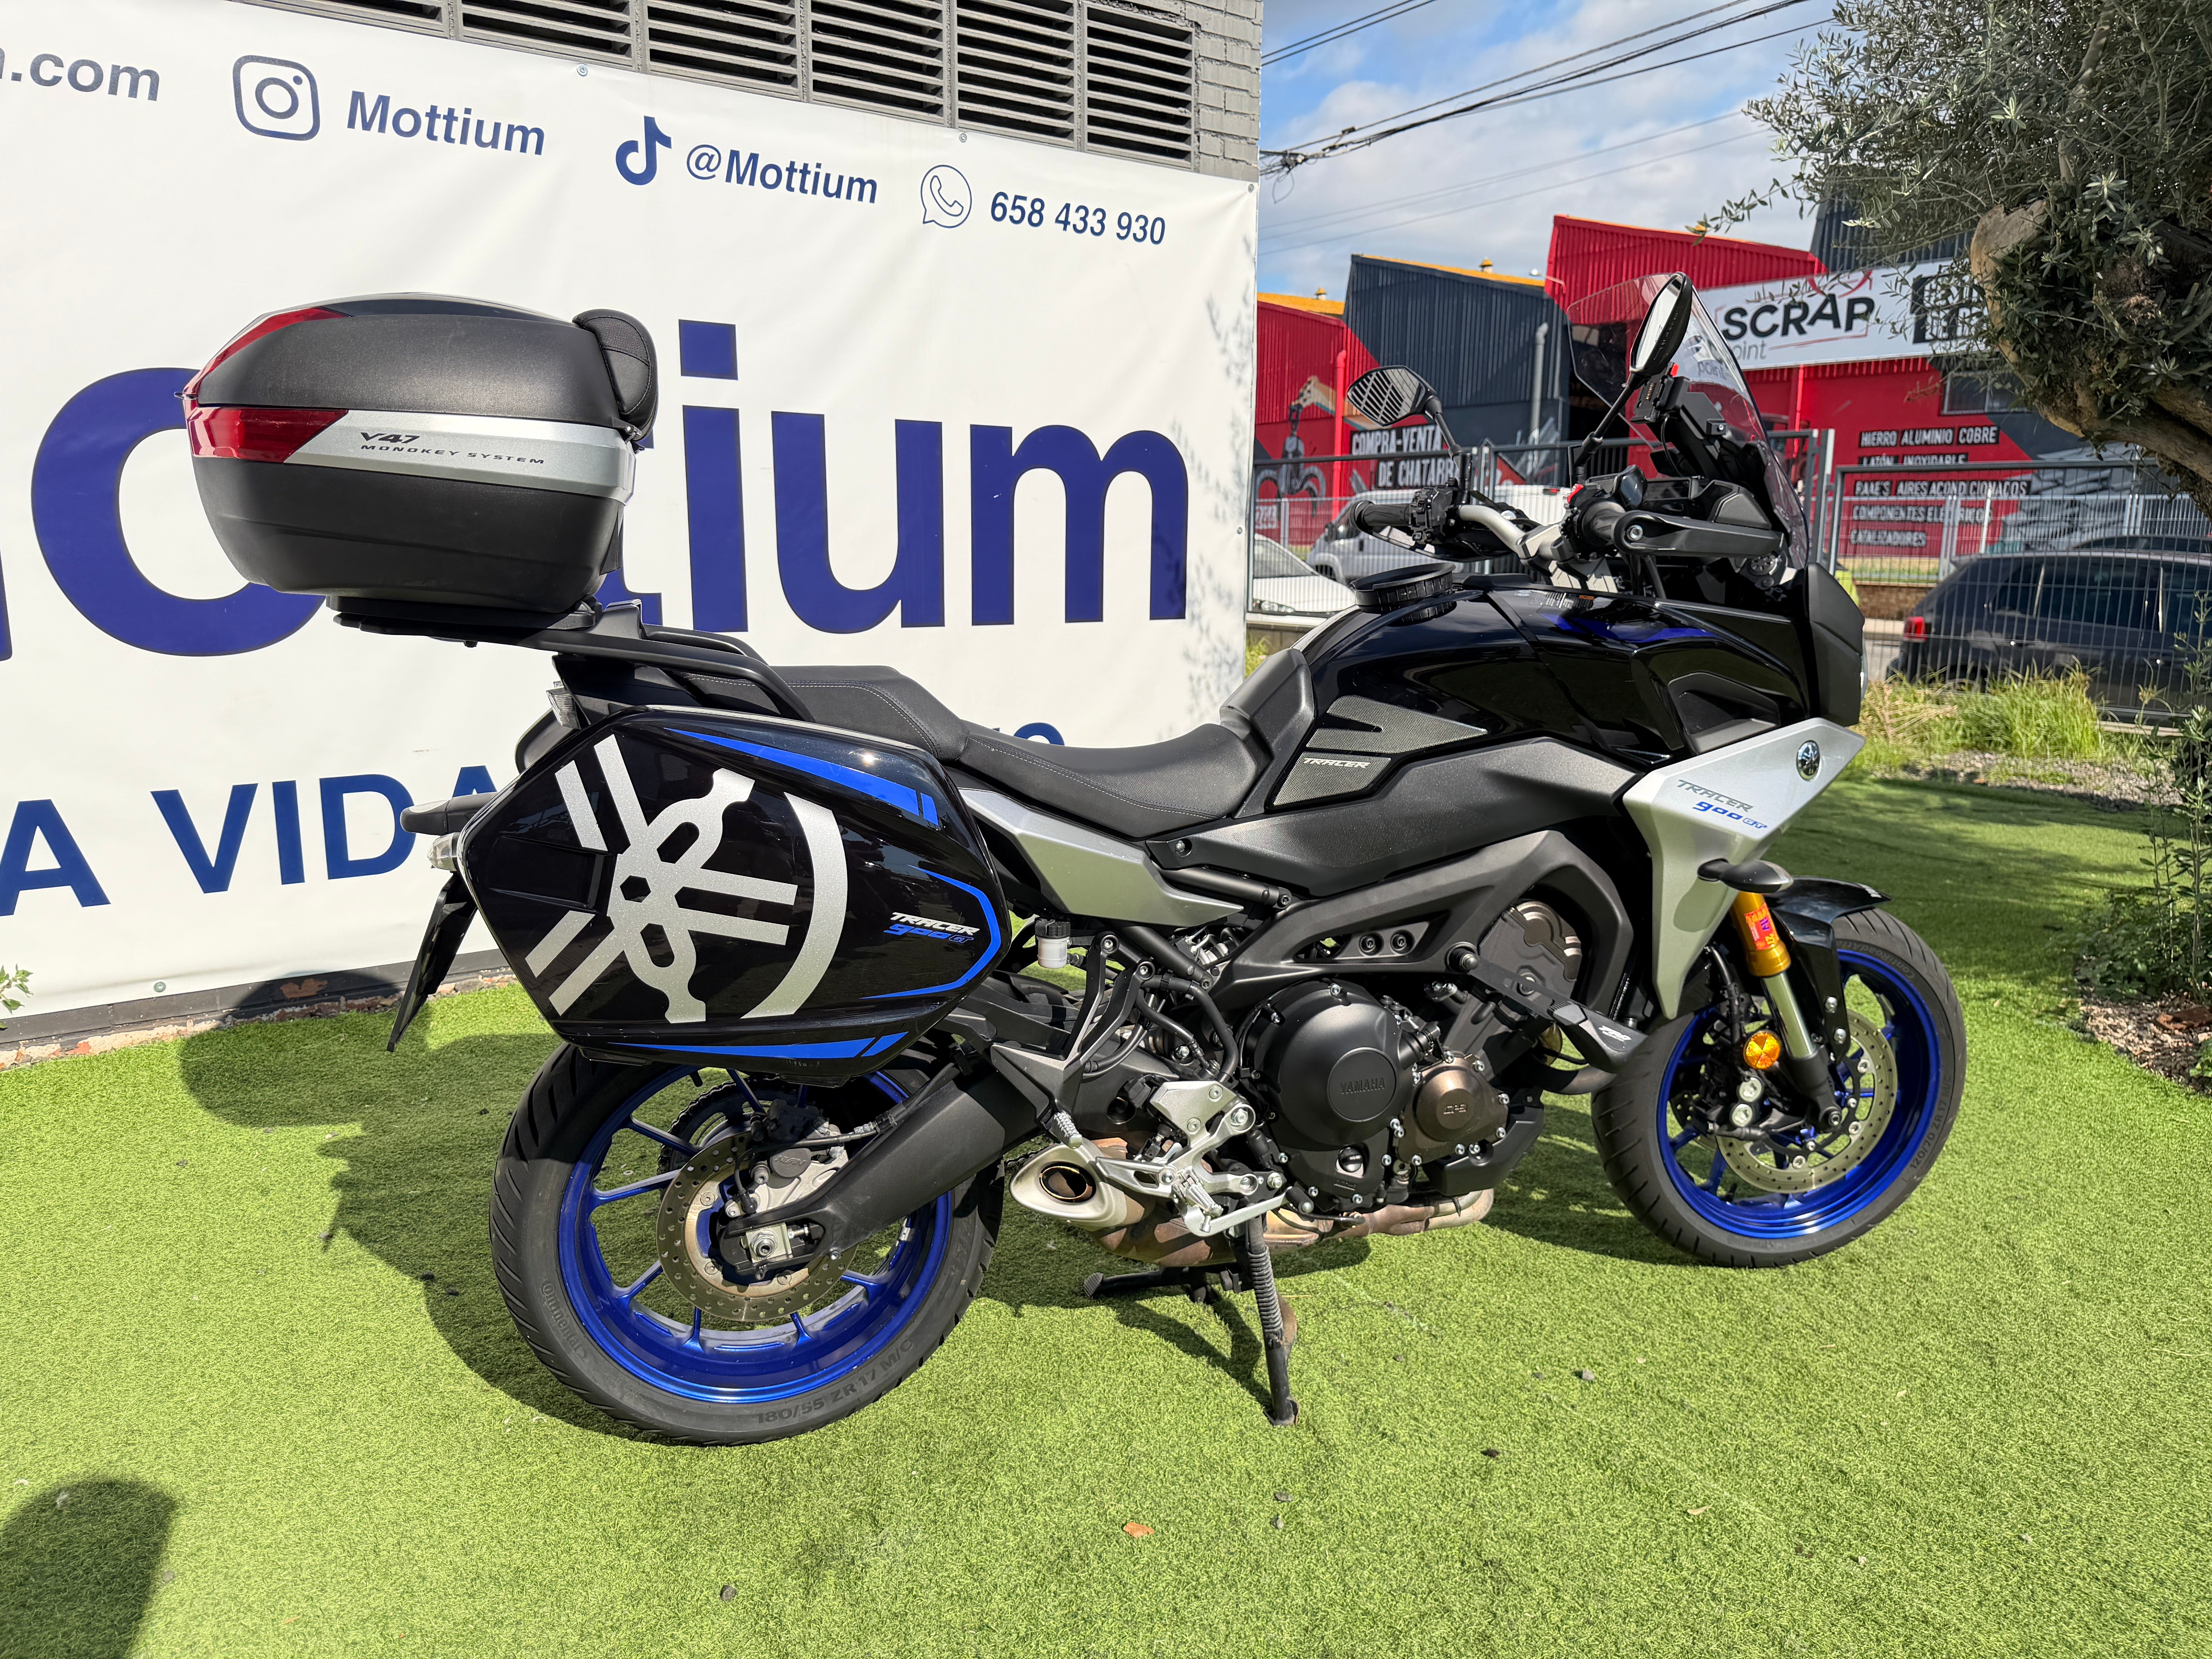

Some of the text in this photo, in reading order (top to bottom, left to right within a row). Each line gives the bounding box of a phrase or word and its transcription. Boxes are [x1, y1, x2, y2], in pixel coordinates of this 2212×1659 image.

[0, 48, 160, 101] .com
[347, 91, 545, 155] Mottium
[686, 144, 878, 204] @Mottium
[990, 192, 1166, 245] 658 433 930
[1722, 293, 1875, 340] SCRAP
[1733, 340, 1767, 361] oint
[361, 432, 420, 443] V47
[1861, 426, 1998, 447] HIERRO ALUMINIO COBRE
[361, 445, 544, 464] MONOKEY SYSTEM
[0, 319, 1189, 658] oium
[1378, 461, 1394, 487] DE
[1897, 481, 1929, 496] AIRES
[1302, 757, 1371, 768] TRACER
[1677, 780, 1754, 812] TRACER
[891, 912, 980, 935] TRACER
[1341, 1078, 1385, 1094] YAMAHA
[1910, 1132, 1935, 1169] 120/70
[756, 1338, 913, 1424] 180/55 ZR 17 M/C
